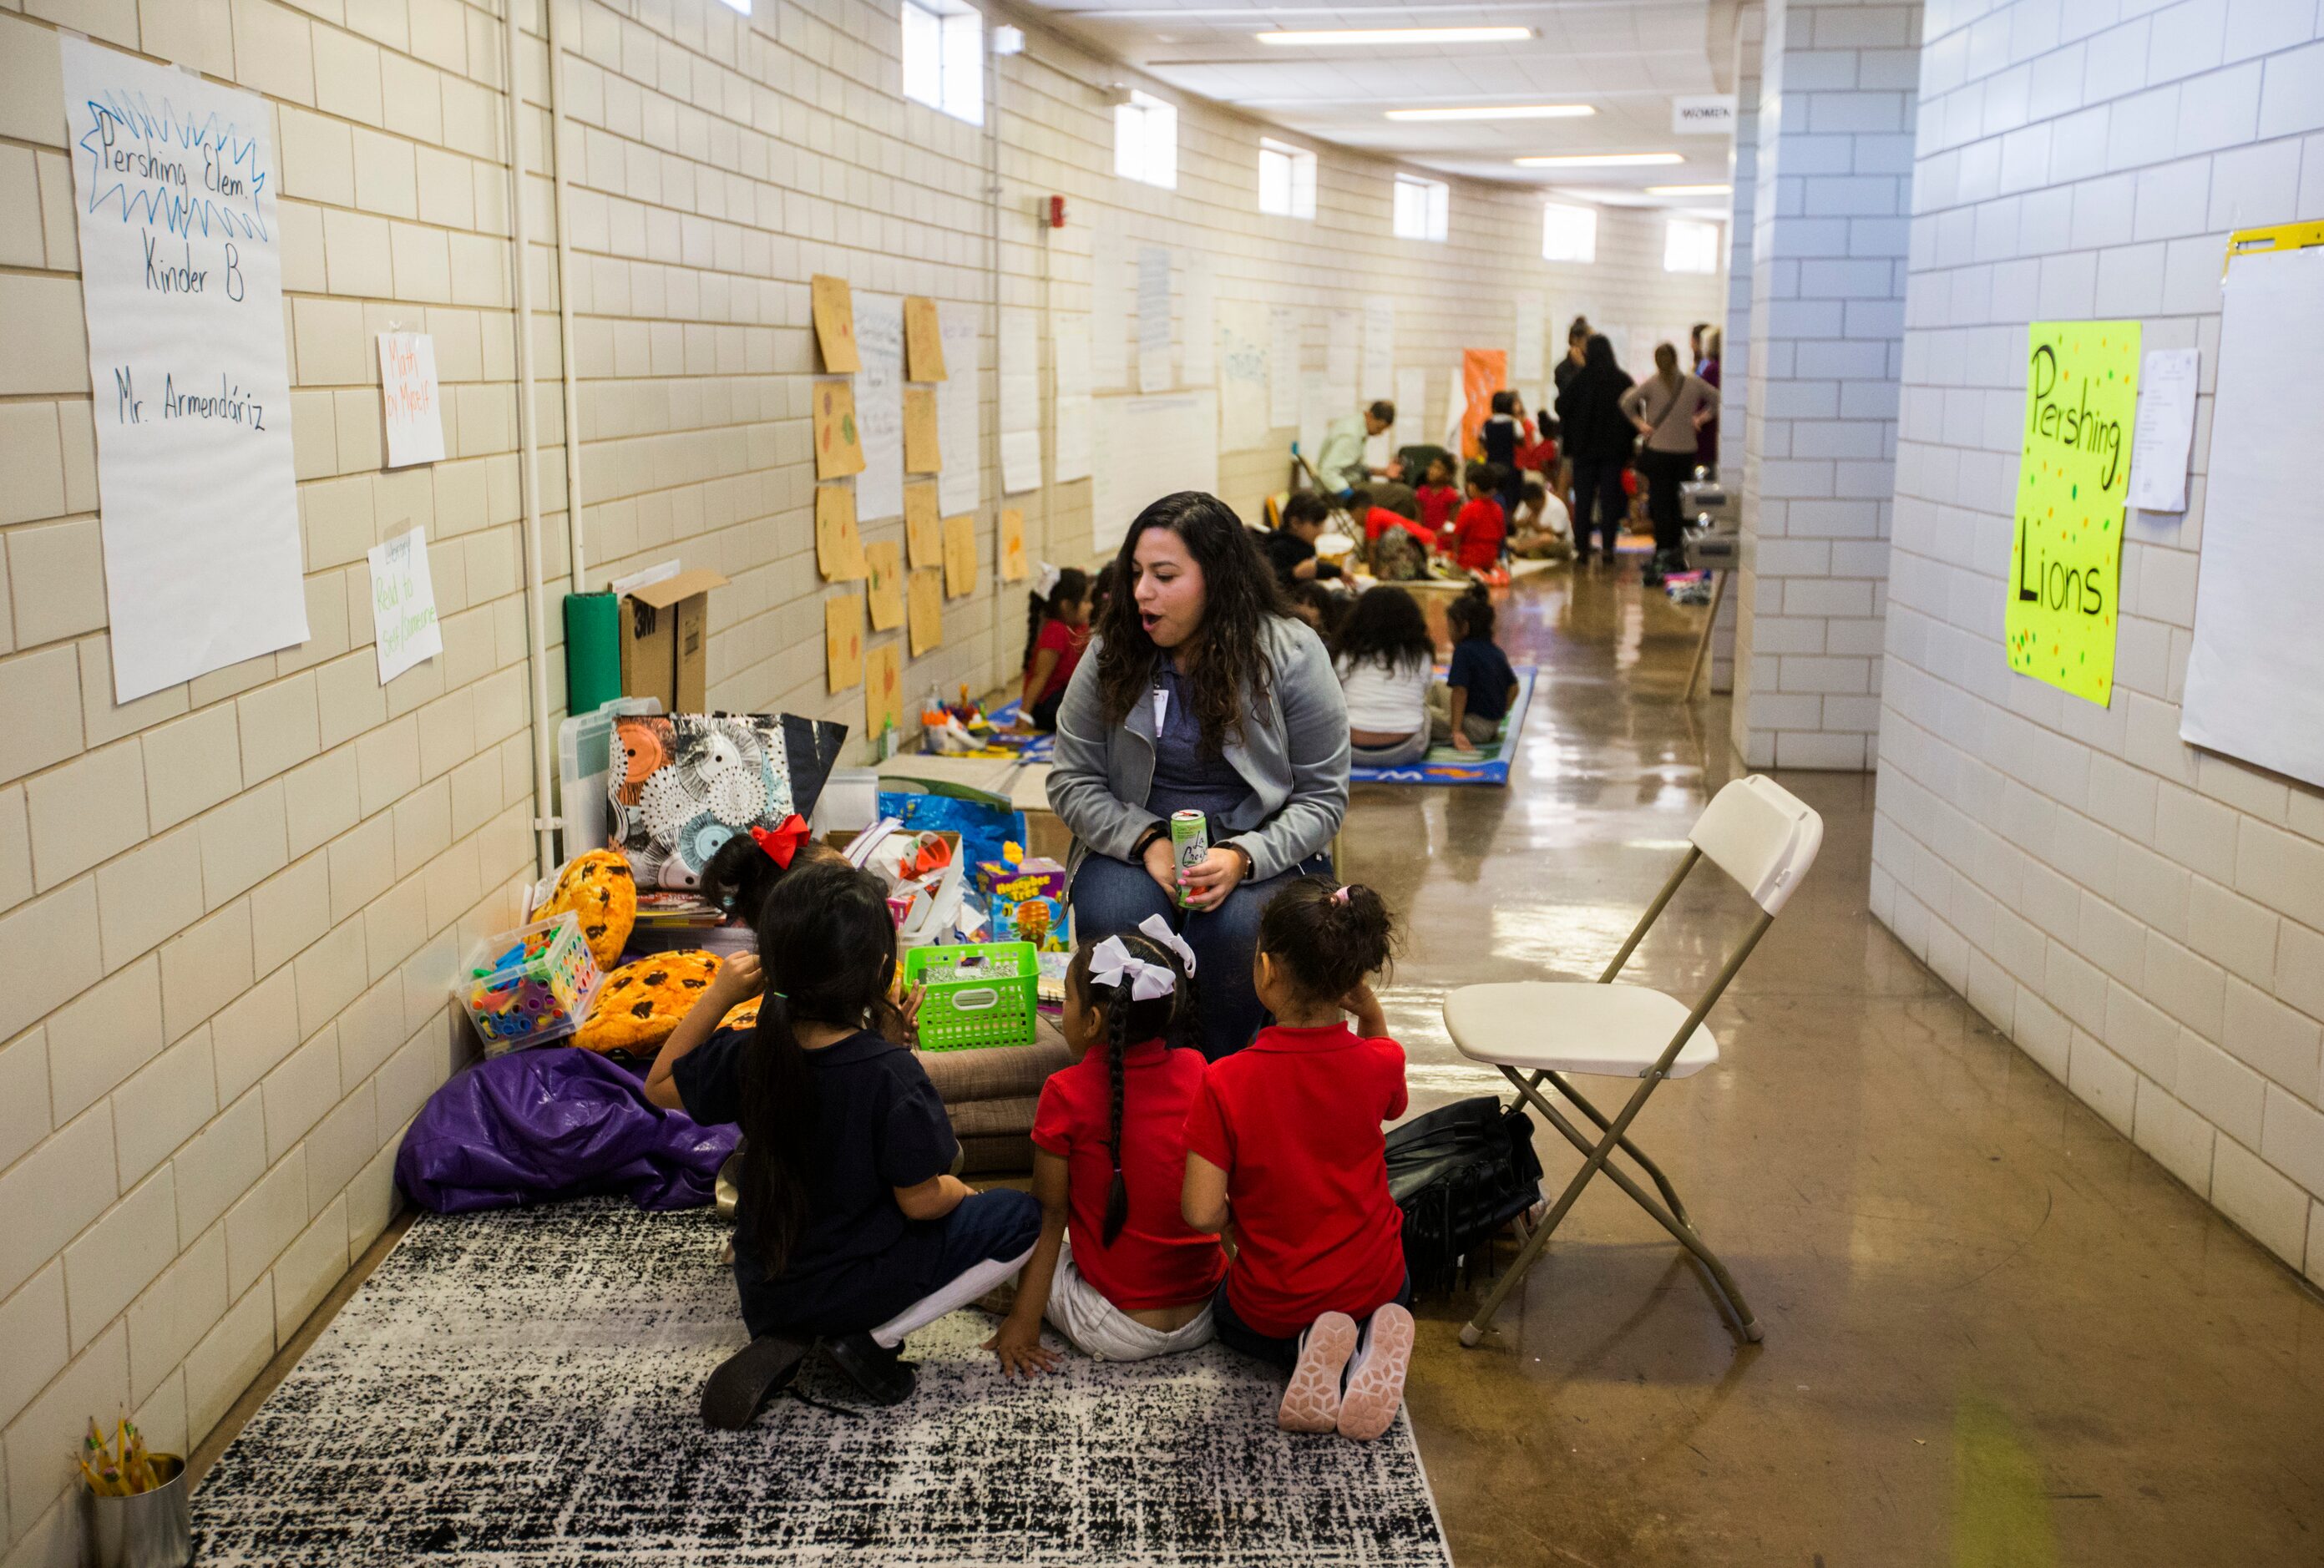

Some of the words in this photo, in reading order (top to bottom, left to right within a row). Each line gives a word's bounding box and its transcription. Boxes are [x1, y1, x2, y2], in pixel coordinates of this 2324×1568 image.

[1682, 108, 1731, 119] WOMEN
[99, 110, 189, 215] Pershing
[203, 143, 248, 200] Elem.
[142, 226, 208, 294] Kinder
[225, 242, 244, 302] B
[388, 336, 418, 379] Math
[114, 365, 148, 424] Mr.
[165, 372, 265, 432] Armendáriz
[2032, 344, 2120, 491] Pershing
[2019, 516, 2103, 615] Lions
[402, 575, 414, 601] to
[635, 603, 656, 640] 3M
[996, 875, 1051, 896] Honeybee
[1011, 886, 1040, 902] Tree
